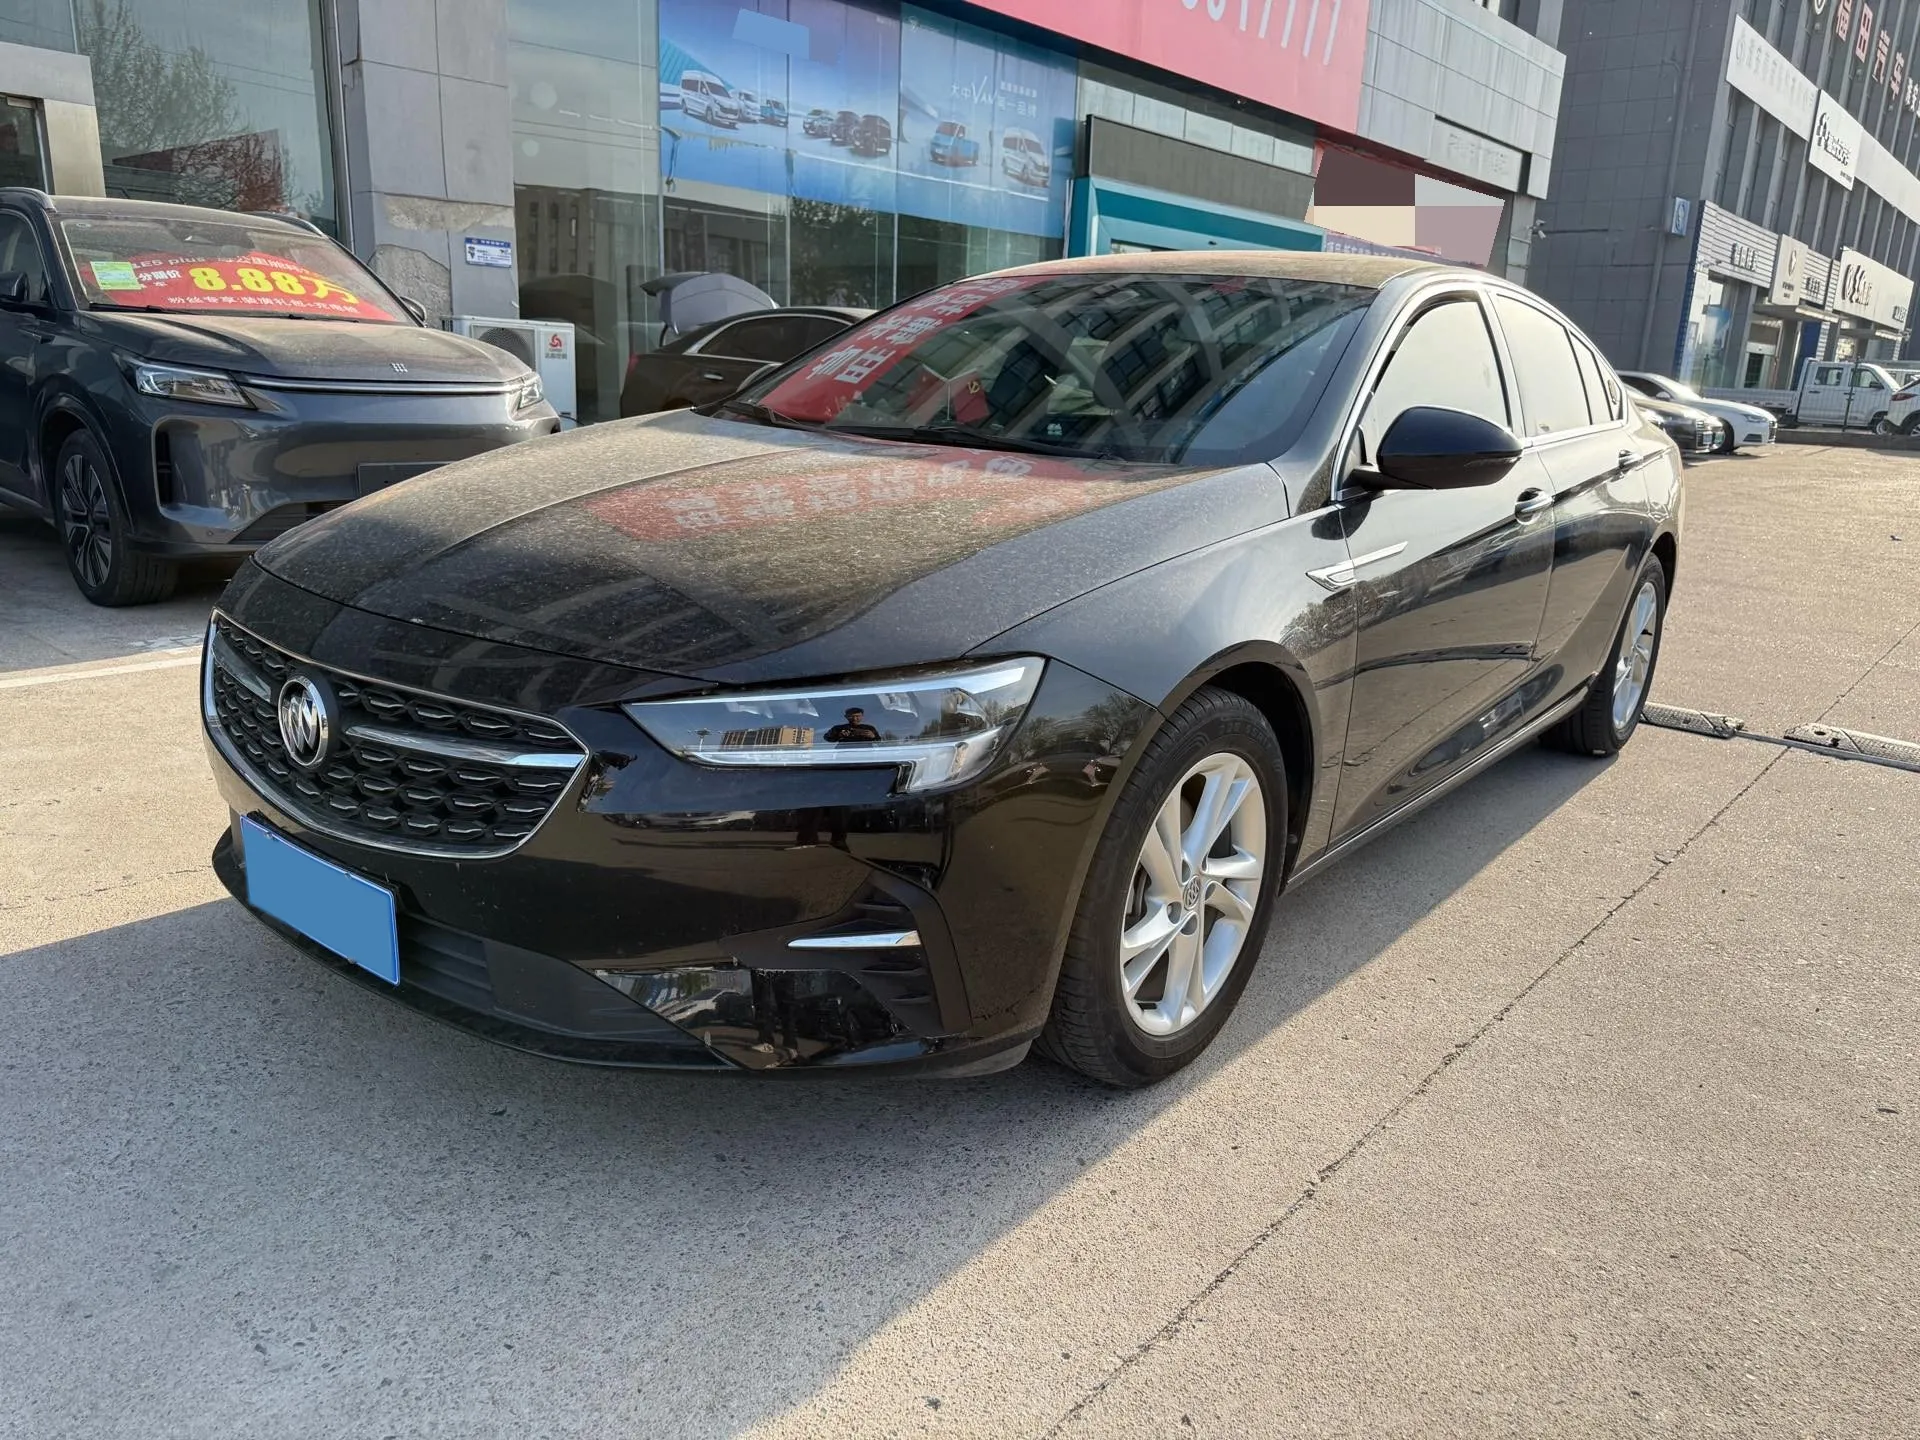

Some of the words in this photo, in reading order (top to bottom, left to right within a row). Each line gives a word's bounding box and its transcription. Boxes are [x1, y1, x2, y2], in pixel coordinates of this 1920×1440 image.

[1836, 0, 1904, 100] 福田汽车
[137, 269, 182, 281] 分期价
[188, 266, 360, 304] 8.88万
